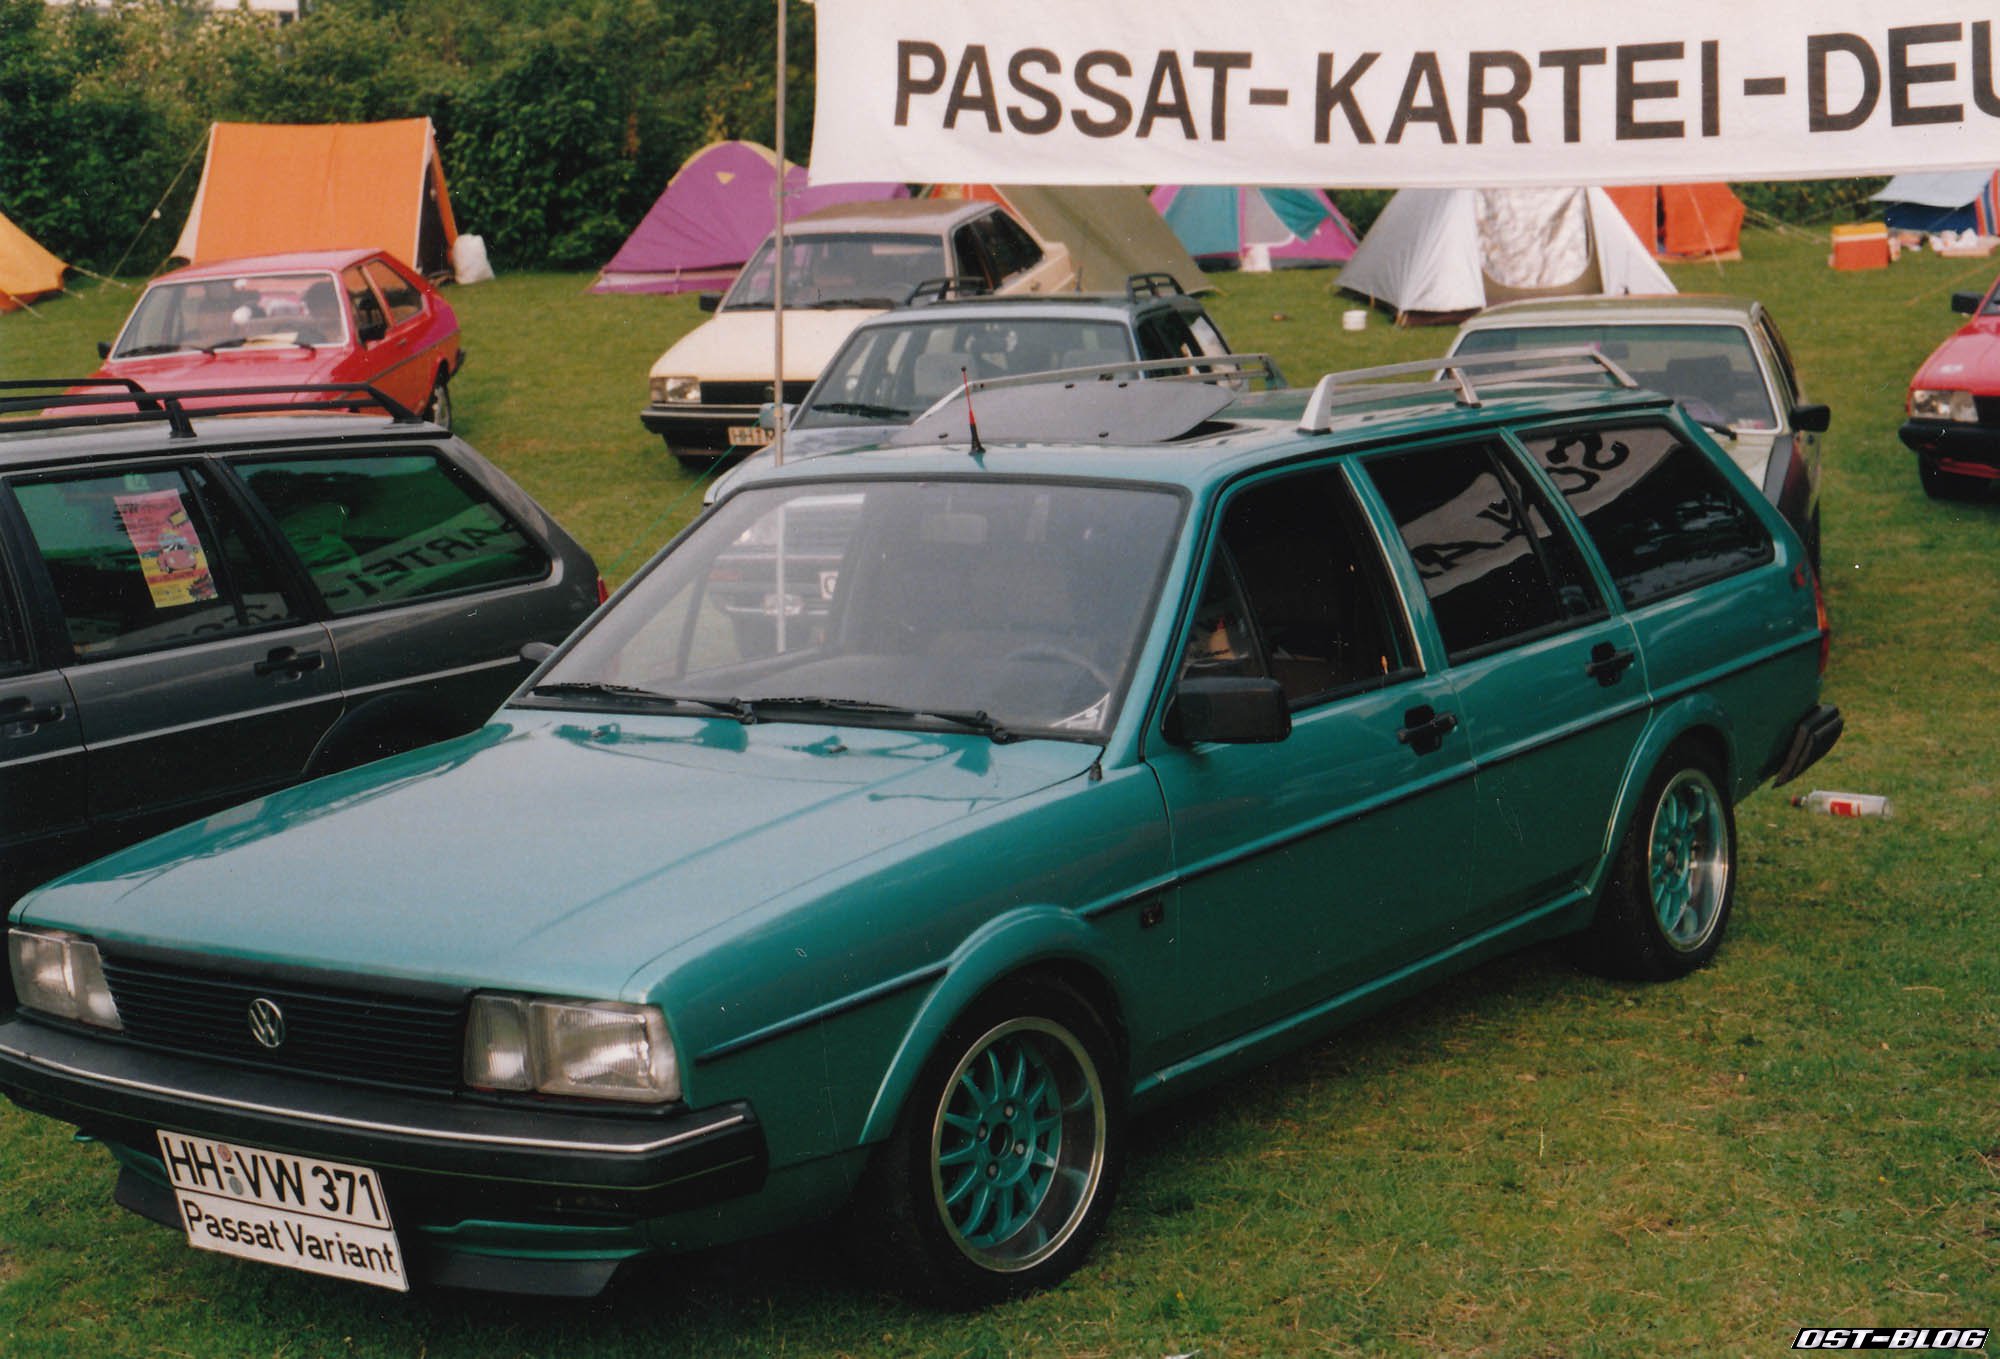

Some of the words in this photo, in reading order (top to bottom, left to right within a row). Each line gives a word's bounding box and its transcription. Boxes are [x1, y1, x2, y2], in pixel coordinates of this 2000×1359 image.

[311, 1165, 382, 1221] 371
[182, 1199, 285, 1252] Passat
[284, 1219, 397, 1273] Variant
